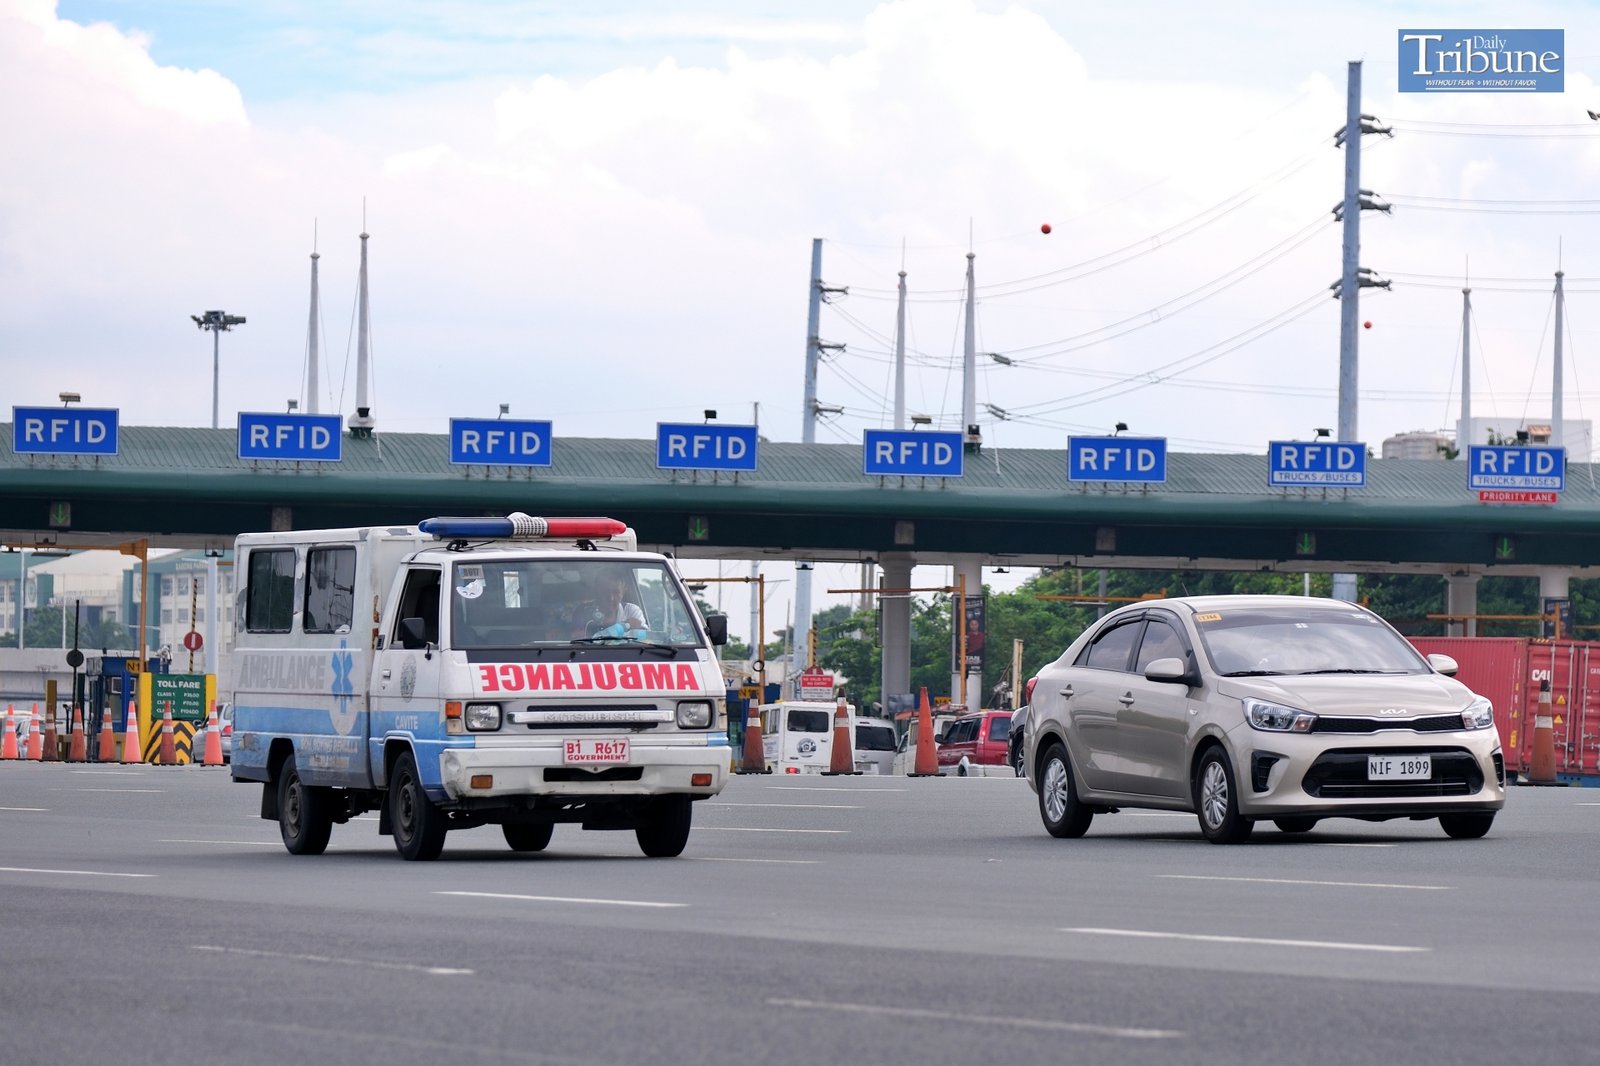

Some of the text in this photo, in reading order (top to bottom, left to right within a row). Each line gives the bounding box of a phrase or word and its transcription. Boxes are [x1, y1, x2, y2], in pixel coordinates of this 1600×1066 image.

[25, 418, 106, 443] RFID
[250, 424, 330, 450] RFID
[461, 430, 541, 455] RFID
[668, 434, 746, 459] RFID
[875, 441, 953, 465] RFID
[1281, 446, 1355, 470] RFID
[1079, 447, 1156, 472] RFID
[1480, 450, 1554, 474] RFID
[1483, 492, 1553, 501] PRIORITY LANE
[238, 654, 327, 690] AMBULANCE
[157, 680, 200, 689] TOLL FARE
[395, 715, 419, 730] CAVITE
[544, 712, 641, 722] MITSUBISHI
[566, 743, 626, 754] B1 R617
[1370, 760, 1429, 775] NIF 1899
